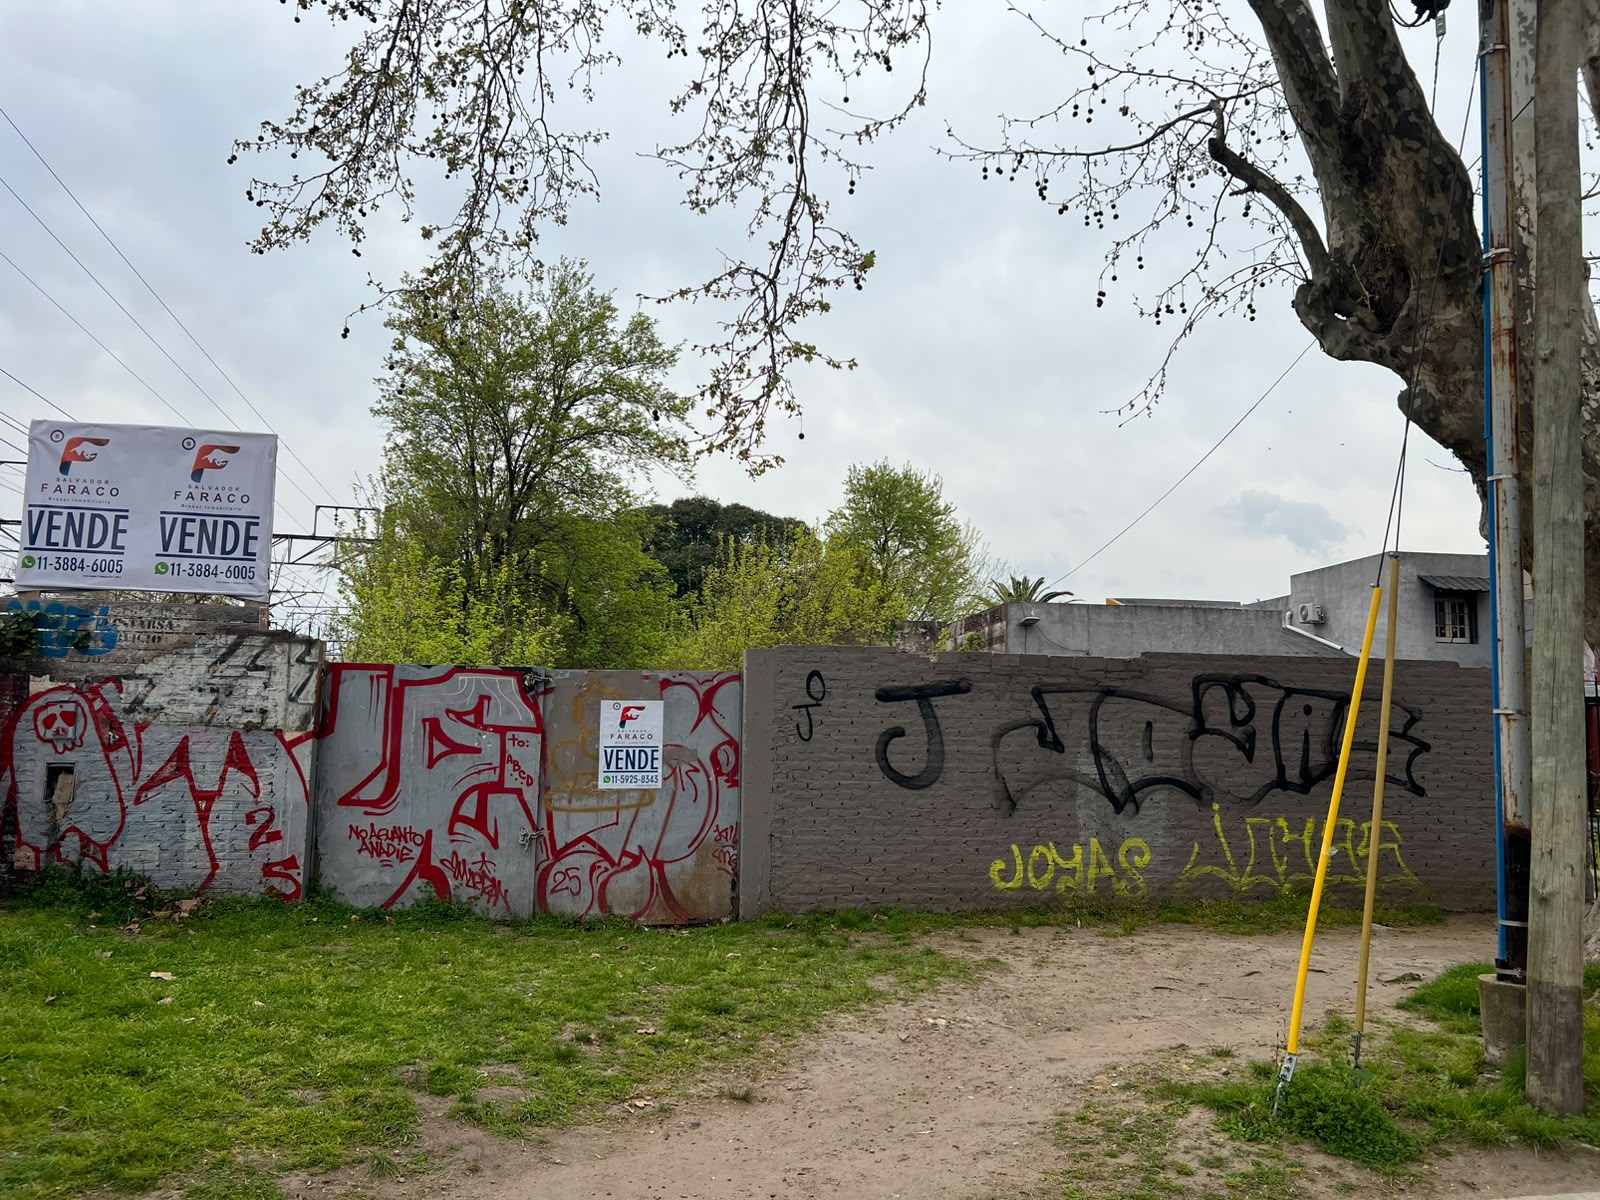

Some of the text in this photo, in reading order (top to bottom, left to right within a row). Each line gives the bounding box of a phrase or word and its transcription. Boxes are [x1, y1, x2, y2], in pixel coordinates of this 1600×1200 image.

[41, 483, 120, 497] FARACO
[56, 477, 109, 485] SALVADOR
[174, 490, 250, 504] FARACO
[28, 509, 129, 550] VENDE
[160, 516, 260, 557] VENDE
[37, 556, 123, 574] 11-3884-6005
[170, 562, 256, 580] 11-3884-6005
[603, 749, 659, 770] VENDE
[506, 753, 534, 787] ABCD
[611, 775, 659, 784] 11-5925-8343
[348, 823, 368, 841] NO
[988, 837, 1152, 898] JOYAS
[550, 867, 582, 897] 25
